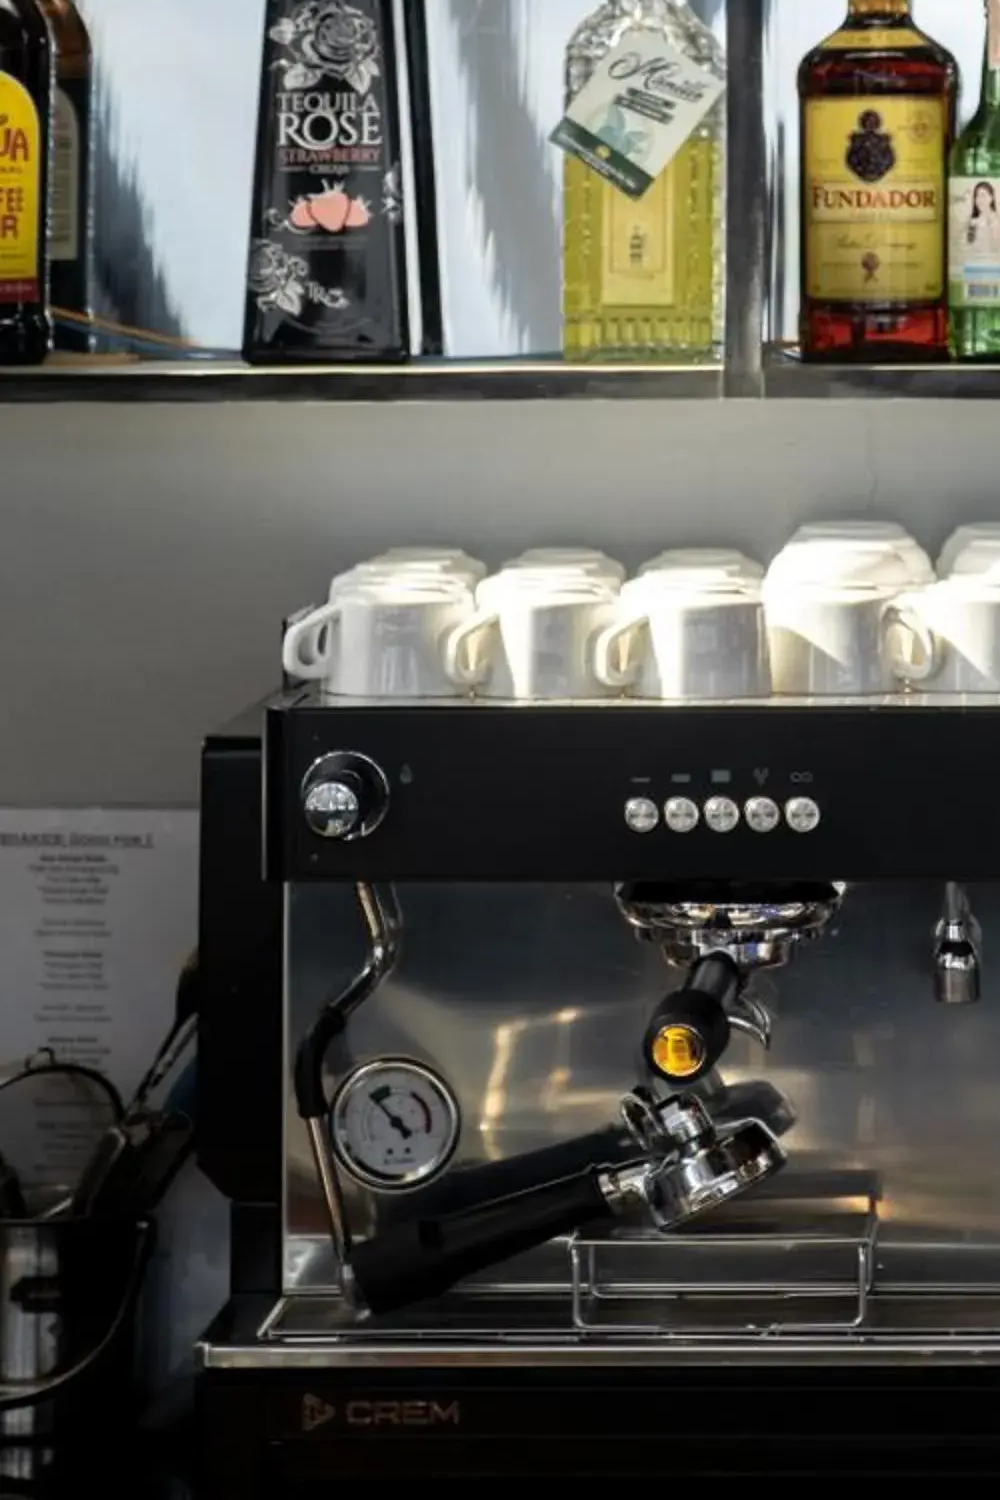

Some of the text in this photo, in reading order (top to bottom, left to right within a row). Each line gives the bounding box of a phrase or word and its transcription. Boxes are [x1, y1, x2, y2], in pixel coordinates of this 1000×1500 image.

[276, 92, 380, 113] TEQUILA
[278, 111, 383, 150] ROSE
[280, 148, 381, 165] STRAWBERRY
[812, 184, 936, 210] FUNDADOR
[346, 1399, 460, 1425] CREM
